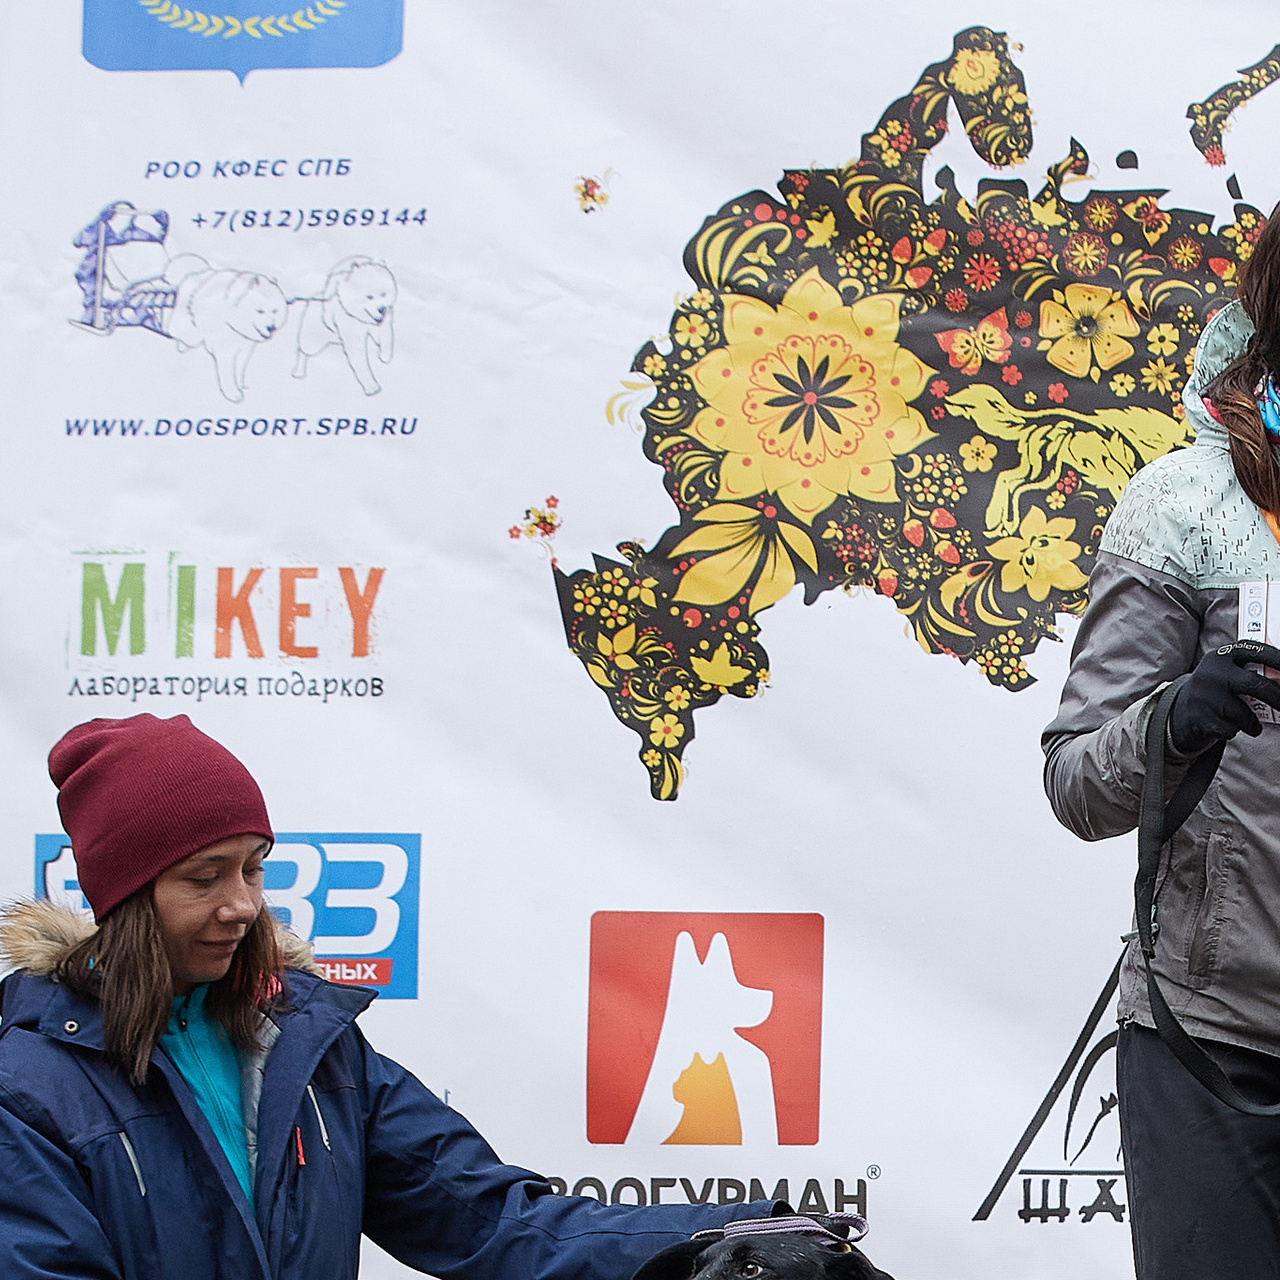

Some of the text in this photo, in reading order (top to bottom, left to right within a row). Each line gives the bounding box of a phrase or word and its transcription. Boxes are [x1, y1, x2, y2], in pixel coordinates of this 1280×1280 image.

[145, 158, 352, 178] РОО КФЕС СПБ
[192, 208, 427, 232] +7(812)5969144
[65, 418, 418, 436] WWW.DOGSPORT.SPB.RU
[80, 561, 387, 659] MIKEY
[68, 672, 384, 702] лаборатория подарков
